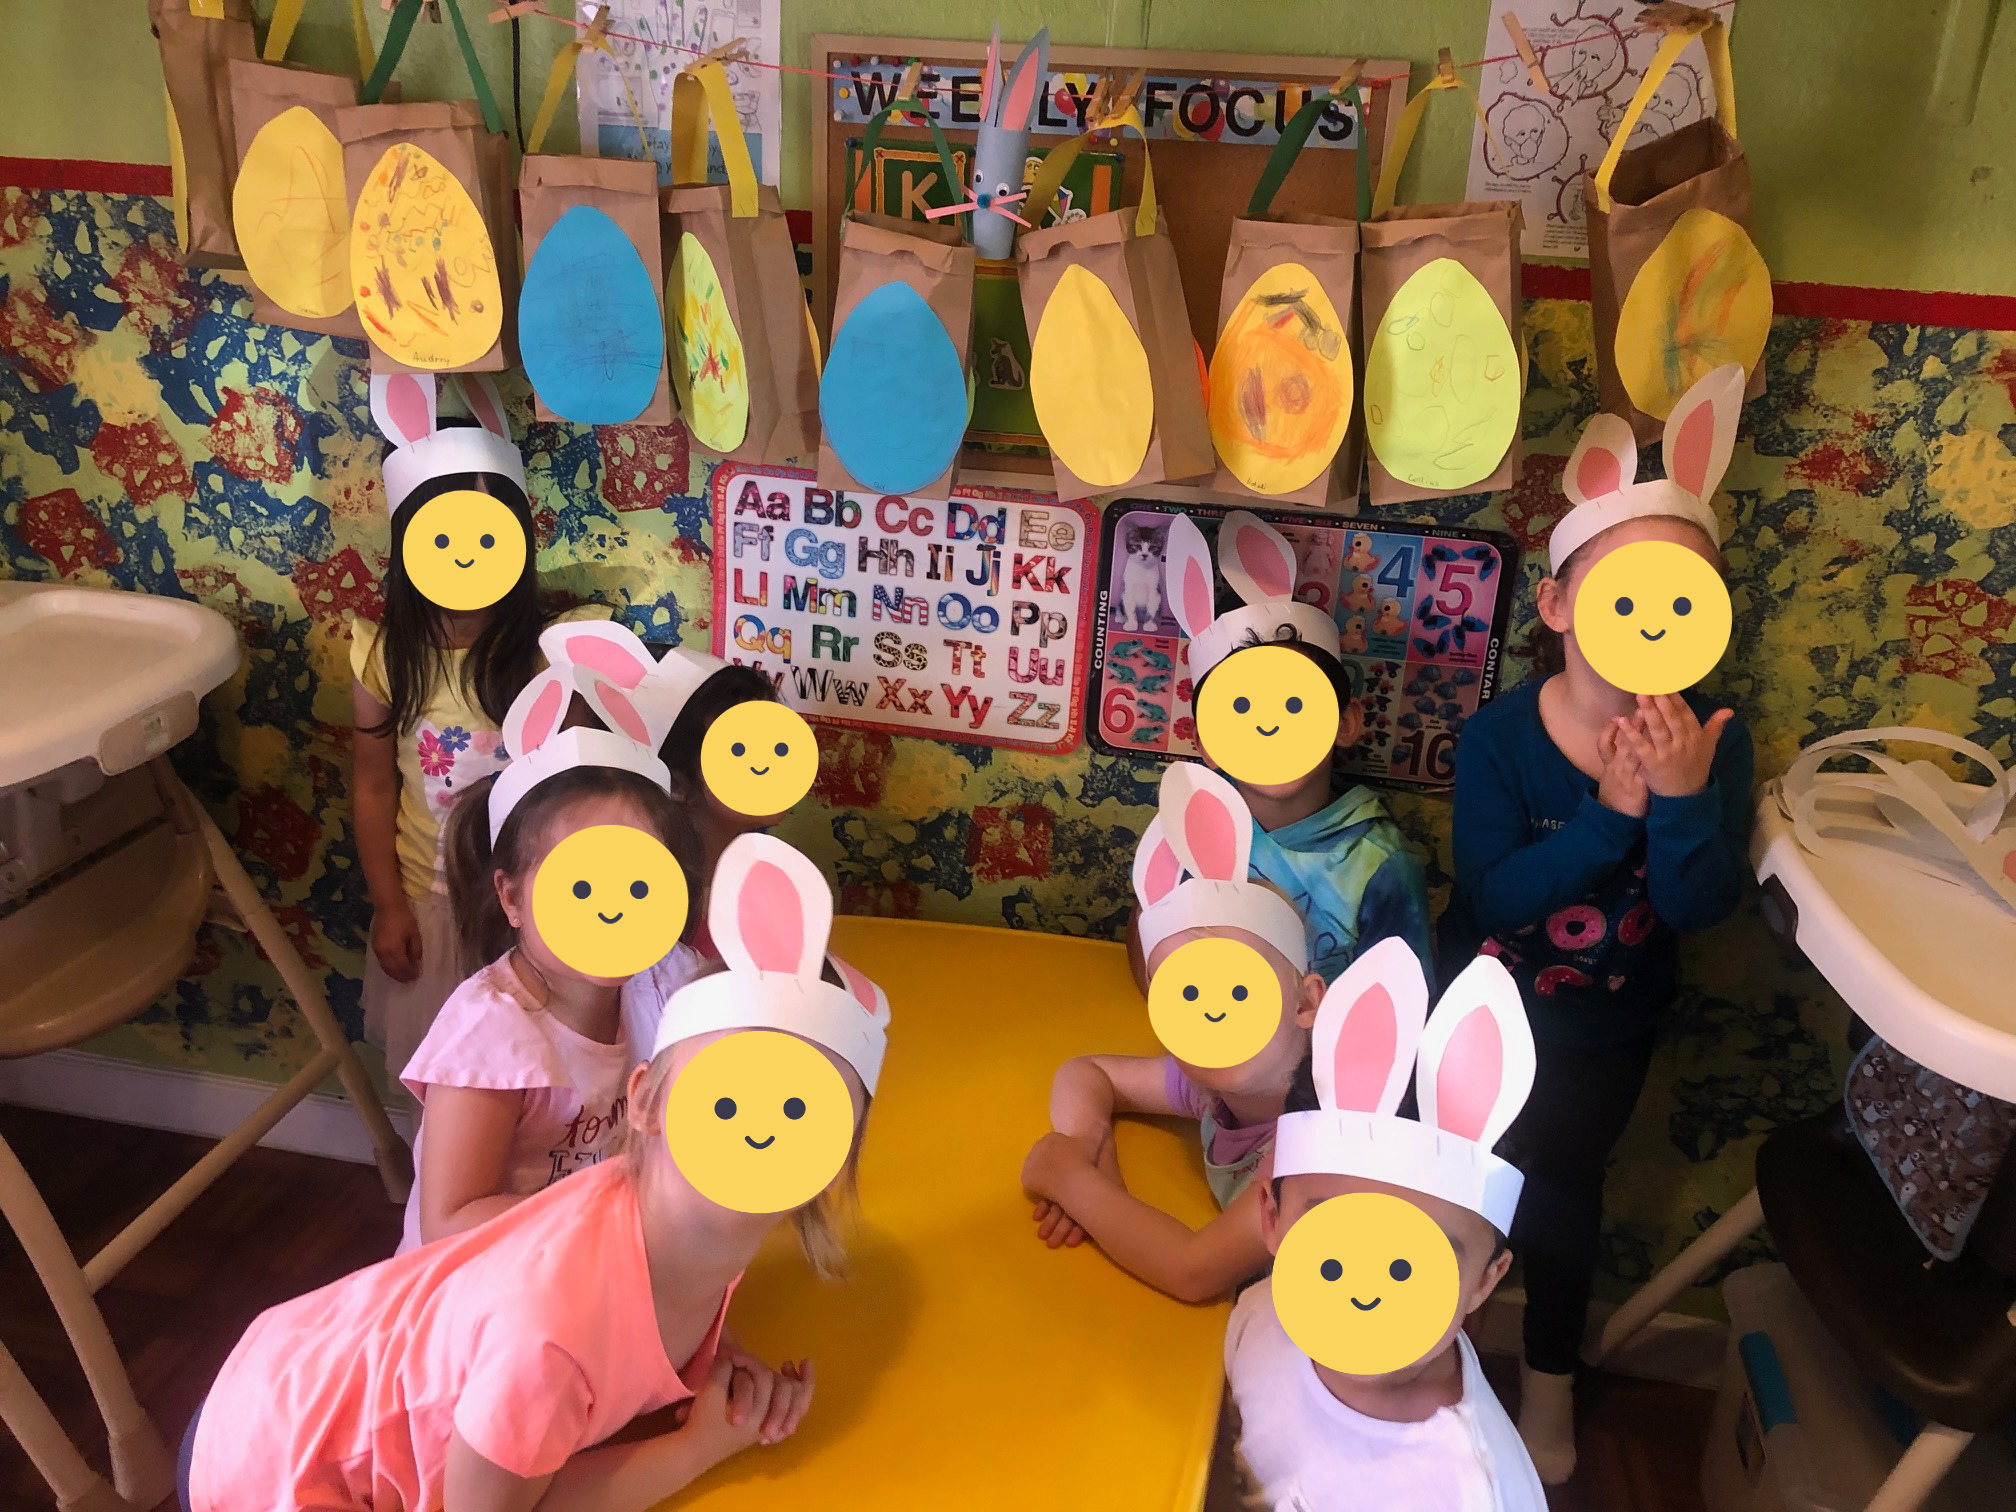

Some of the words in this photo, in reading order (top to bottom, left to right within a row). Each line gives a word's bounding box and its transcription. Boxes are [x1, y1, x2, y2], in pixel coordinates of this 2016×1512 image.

[851, 71, 1097, 127] WEELY
[901, 169, 939, 218] K
[412, 351, 451, 367] Audrey
[734, 480, 791, 522] Aa
[804, 487, 862, 529] Bb
[875, 495, 934, 537] Cc
[946, 502, 1007, 545] Dd
[1019, 509, 1076, 552] Ee
[1163, 505, 1187, 513] TWO
[1196, 508, 1227, 518] THRE
[1282, 516, 1309, 526] FIVE
[1315, 519, 1332, 527] SIX
[1342, 520, 1379, 531] SEVEN
[1431, 529, 1459, 538] NINE
[733, 521, 775, 562] Ff
[784, 528, 846, 580] Gg
[857, 536, 915, 578] Hh
[926, 543, 955, 583] Ii
[965, 543, 1002, 597] Jj
[1011, 552, 1073, 595] Kk
[1377, 545, 1416, 598] 4
[733, 568, 768, 607] Ll
[783, 574, 858, 618] Mm
[872, 584, 930, 626] Nn
[937, 592, 1000, 634] Oo
[1010, 600, 1069, 648] Pp
[1436, 564, 1475, 616] 5
[733, 614, 792, 665] Qq
[811, 624, 860, 663] Rr
[872, 630, 929, 672] Ss
[943, 638, 987, 679] Tt
[1007, 646, 1066, 687] Uu
[1094, 590, 1108, 669] COUNTING
[1481, 637, 1500, 700] CONTAR
[789, 665, 870, 707] Ww
[875, 675, 933, 716] Xx
[940, 683, 994, 730] Yy
[1006, 691, 1062, 730] Zz
[1103, 687, 1136, 734] 6
[1401, 729, 1458, 780] 10
